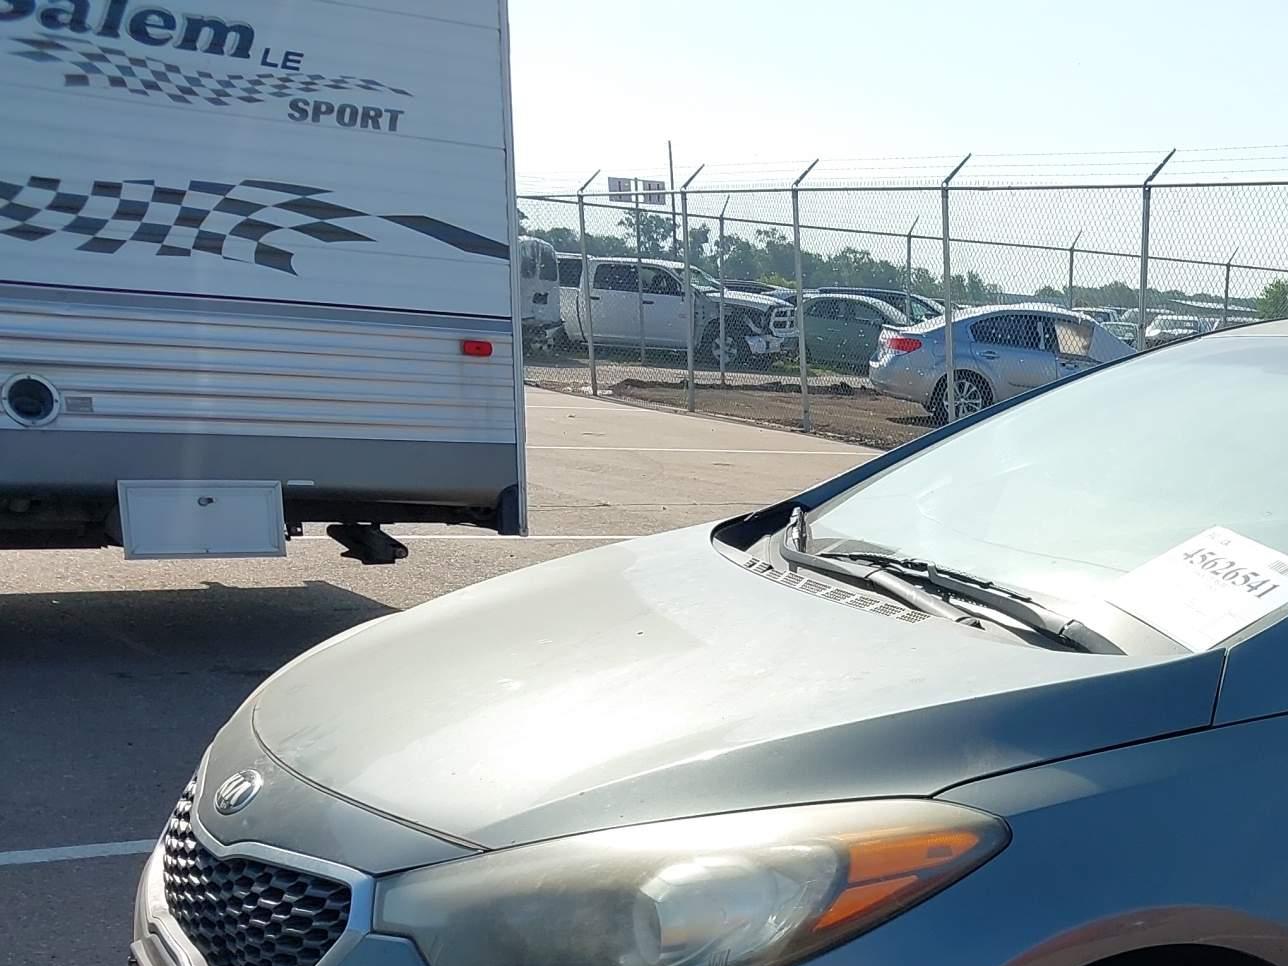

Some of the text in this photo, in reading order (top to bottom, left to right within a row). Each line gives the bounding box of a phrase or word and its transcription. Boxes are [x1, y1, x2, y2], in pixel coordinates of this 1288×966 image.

[0, 0, 304, 71] alem LE
[288, 98, 404, 132] SPORT
[1183, 547, 1280, 599] 45626541
